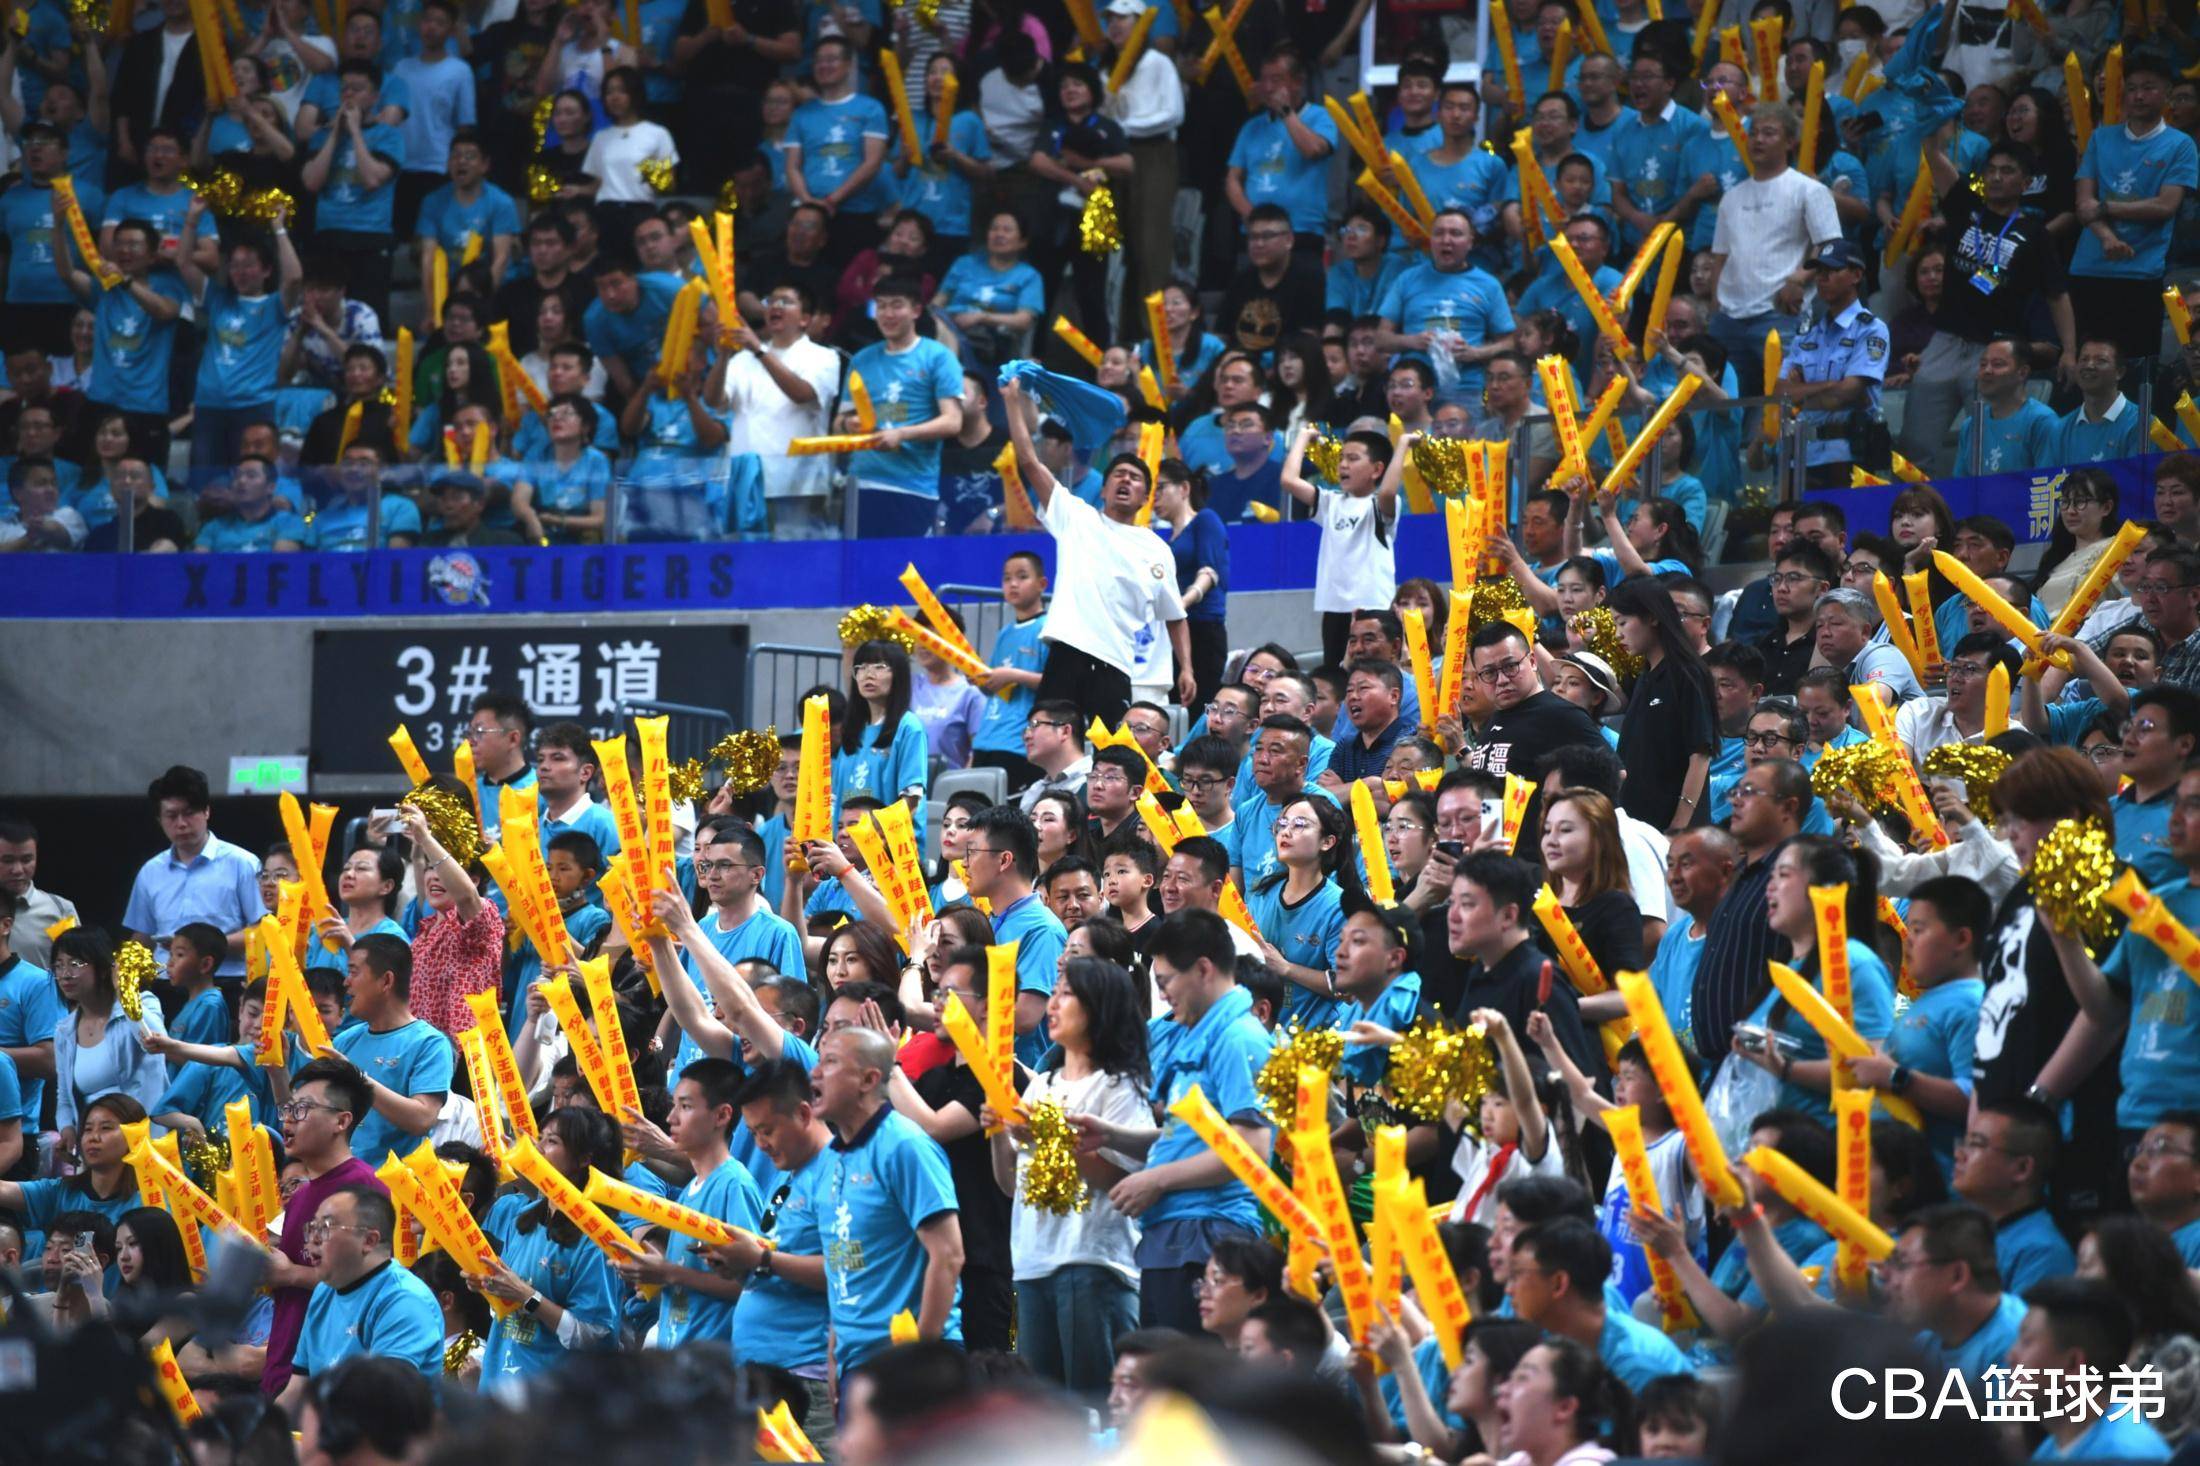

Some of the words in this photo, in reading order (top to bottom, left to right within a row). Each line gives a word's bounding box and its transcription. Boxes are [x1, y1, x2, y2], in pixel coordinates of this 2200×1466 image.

[508, 550, 736, 602] TIGERS
[394, 646, 492, 715] 3#
[518, 641, 661, 716] 通道
